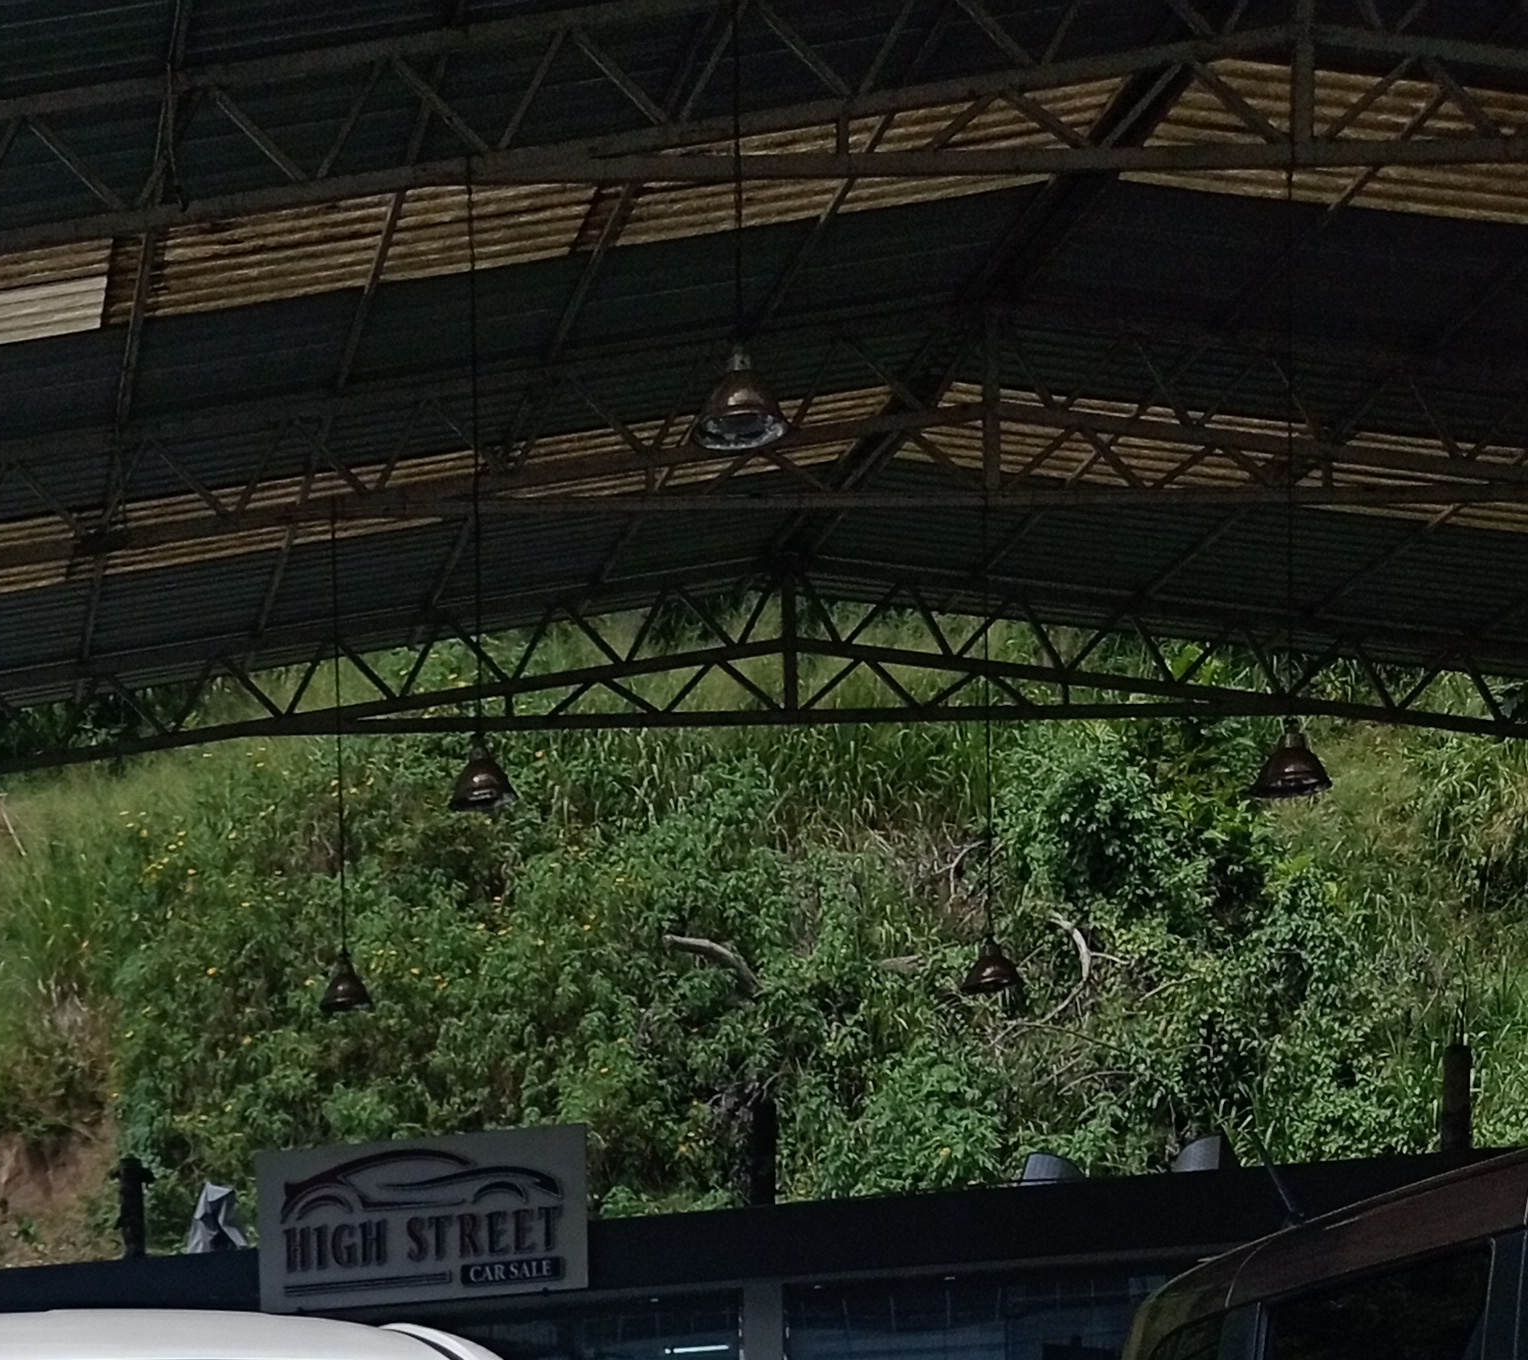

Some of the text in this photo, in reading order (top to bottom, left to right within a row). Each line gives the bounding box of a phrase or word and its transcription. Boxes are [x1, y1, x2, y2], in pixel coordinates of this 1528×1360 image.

[283, 1205, 563, 1273] HIGH STREET
[469, 1259, 552, 1283] CAR SALE
